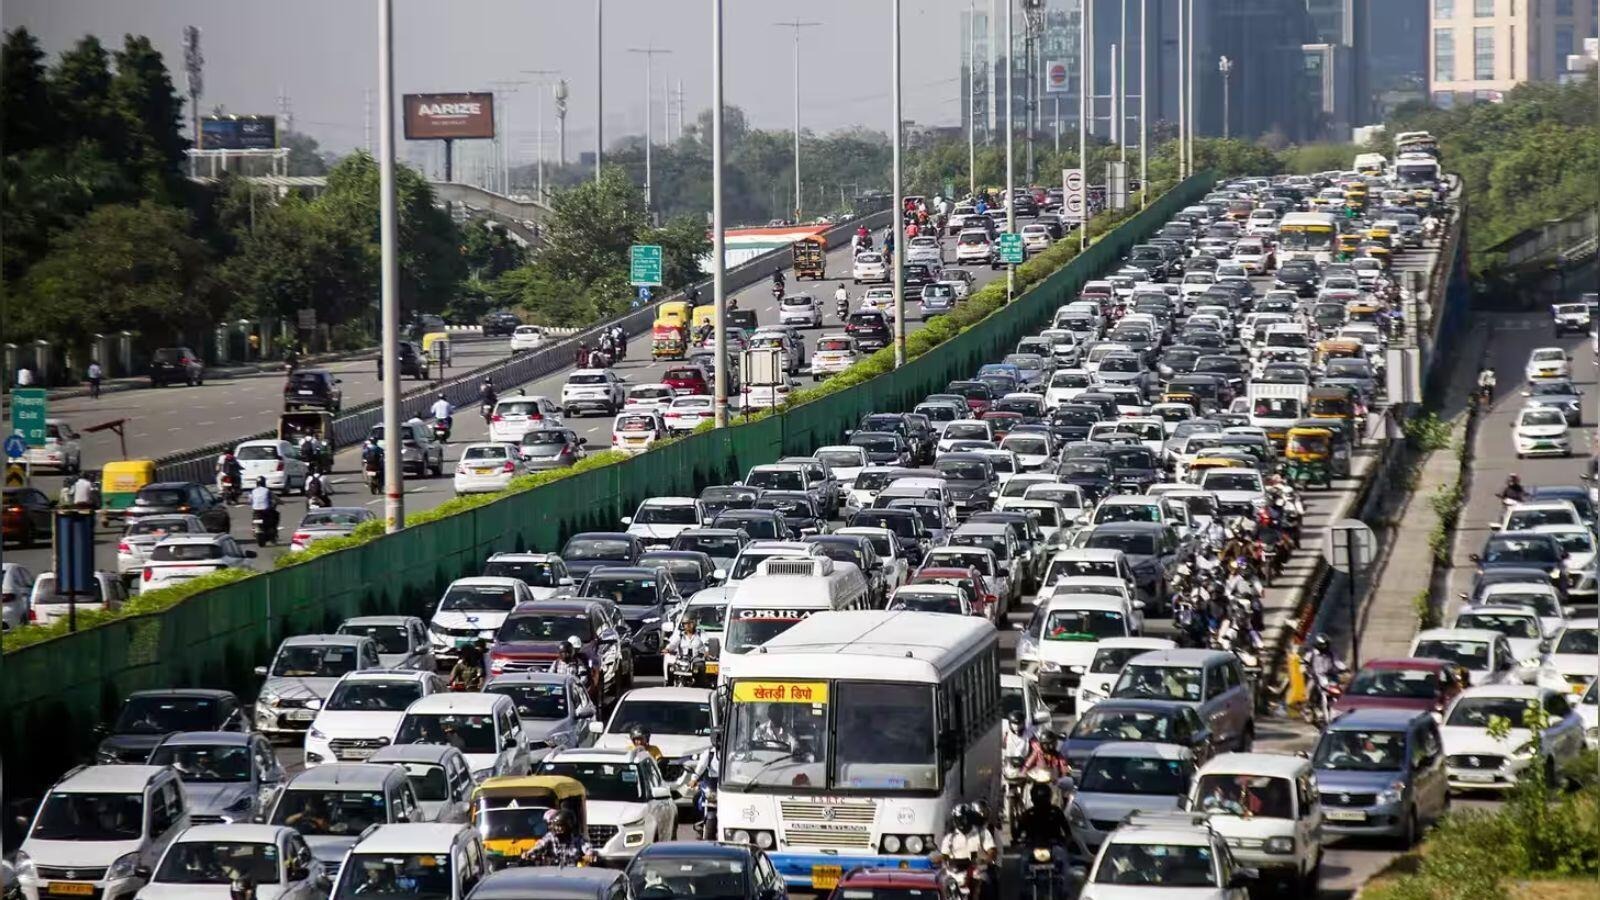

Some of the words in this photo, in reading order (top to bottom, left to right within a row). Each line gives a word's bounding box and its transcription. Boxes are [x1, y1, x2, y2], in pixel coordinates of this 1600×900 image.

[418, 103, 481, 116] AARIZE
[19, 411, 38, 419] Exit
[754, 684, 785, 702] खेतड़ी
[790, 685, 812, 700] डिपो
